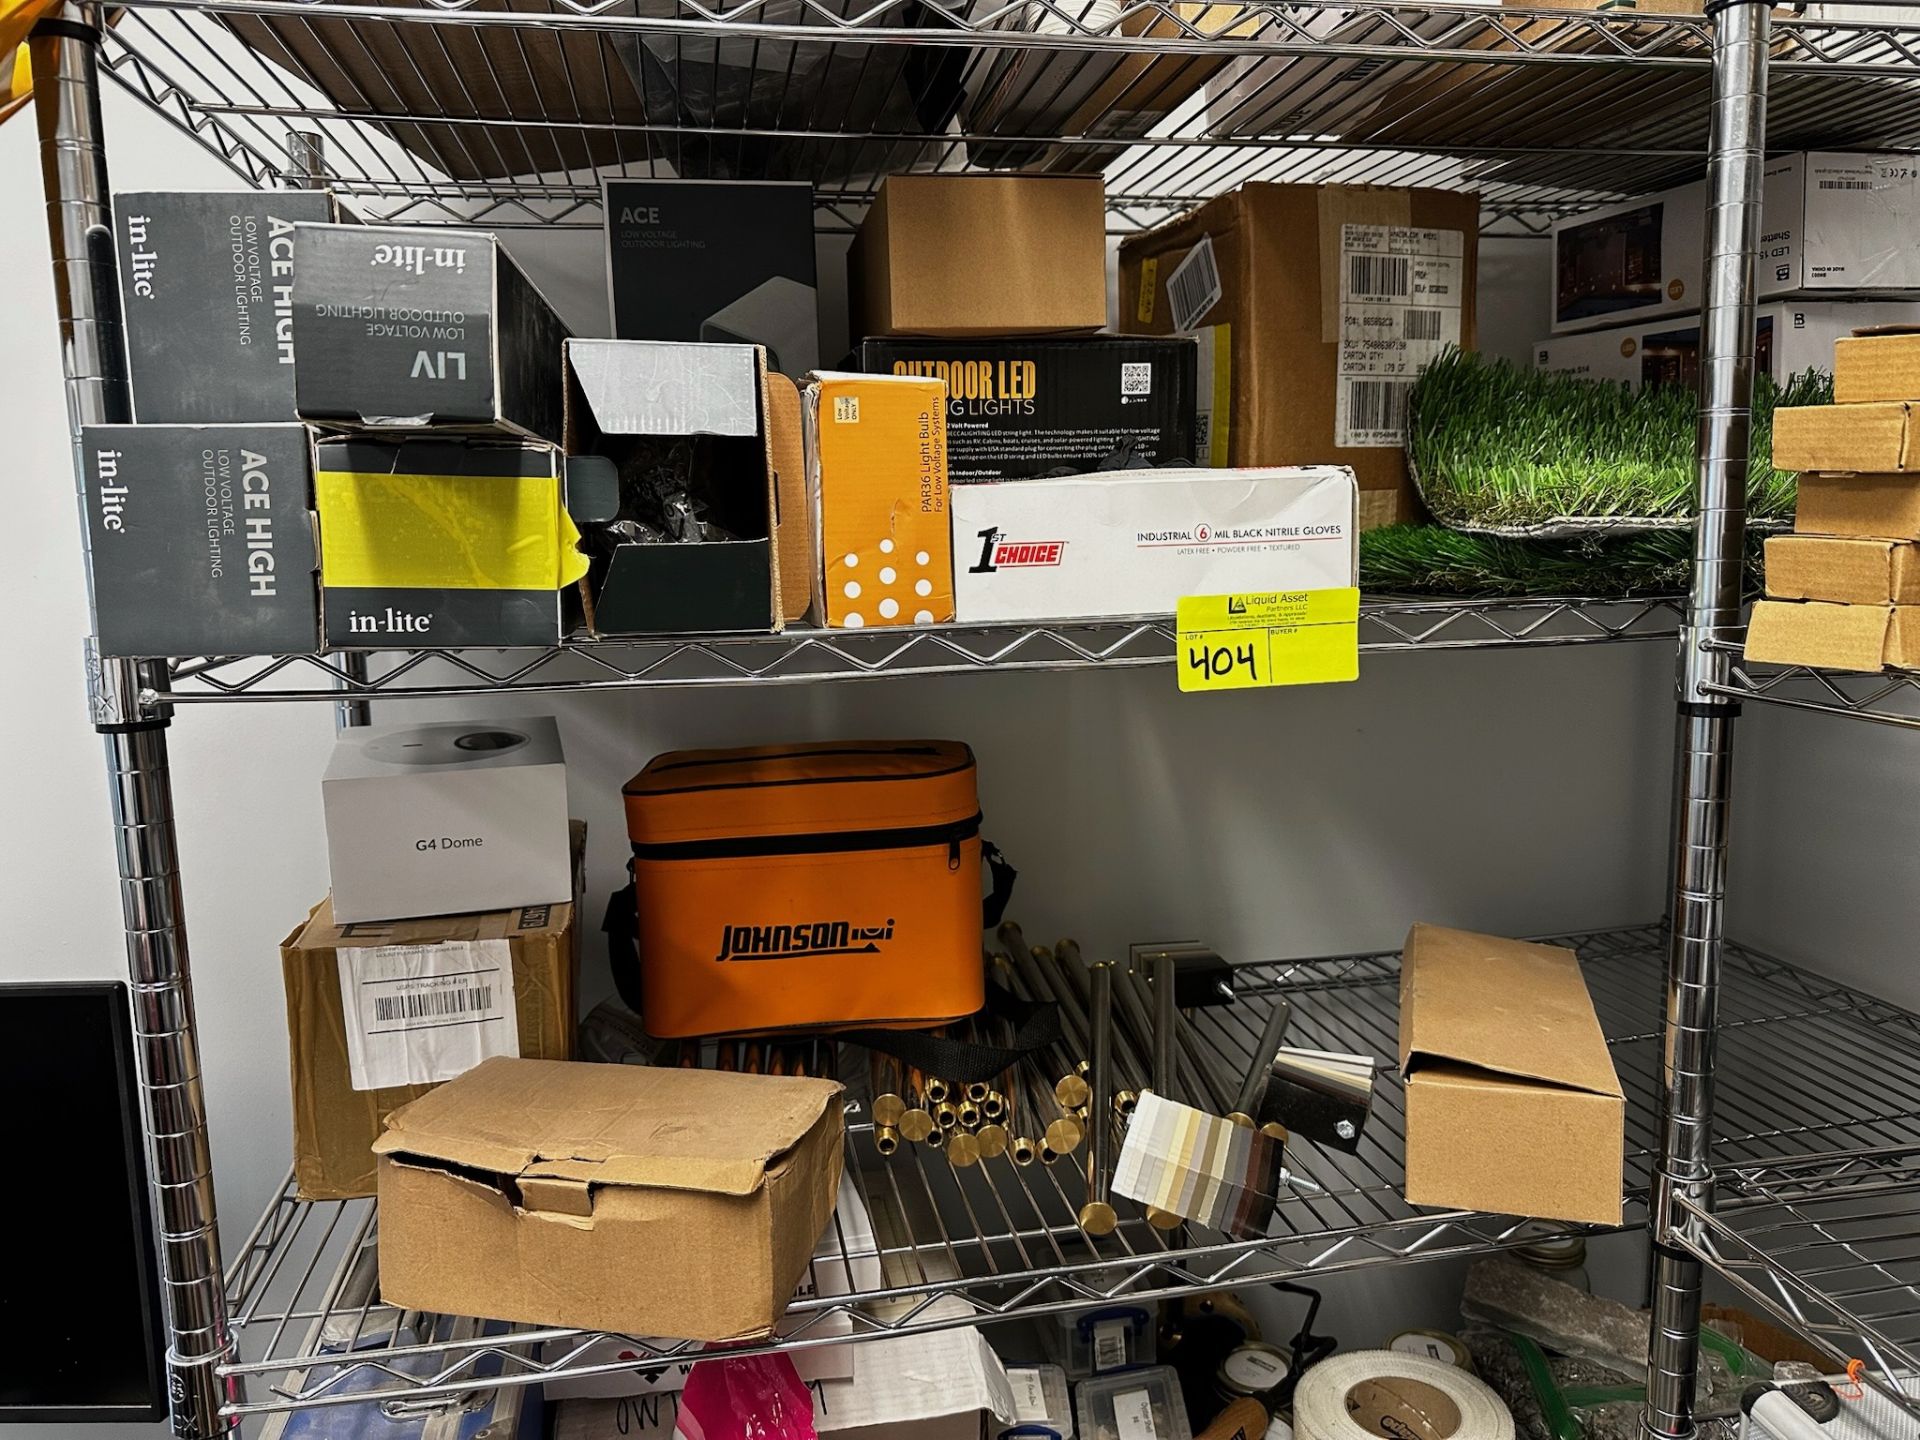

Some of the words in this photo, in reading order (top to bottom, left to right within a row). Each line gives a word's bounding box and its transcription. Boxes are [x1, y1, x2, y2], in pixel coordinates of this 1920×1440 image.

[620, 207, 660, 224] ACE
[244, 216, 255, 244] LOW
[621, 231, 639, 239] LOW
[640, 230, 678, 239] VOLTAGE
[127, 215, 156, 299] in-lite
[230, 215, 247, 280] OUTDOOR
[267, 215, 295, 278] ACE
[621, 239, 665, 249] OUTDOOR
[666, 240, 706, 249] LIGHTING
[1771, 246, 1791, 257] LED
[371, 244, 466, 275] in-lite
[247, 245, 263, 303] VOLTAGE
[236, 281, 251, 345] LIGHTING
[273, 285, 296, 364] HIGH
[316, 304, 391, 320] LIGHTING
[394, 308, 464, 322] OUTDOOR
[366, 323, 432, 338] VOLTAGE
[433, 325, 465, 341] LOW
[410, 350, 467, 380] LIV
[1343, 351, 1366, 361] CARTON
[1343, 362, 1366, 371] CARTON
[999, 361, 1036, 399] LED
[931, 396, 943, 435] Systems
[969, 400, 1035, 416] LIGHTS
[918, 411, 930, 438] Bulb
[217, 449, 229, 476] LOW
[919, 441, 933, 473] Light
[932, 438, 945, 473] Voltage
[97, 449, 127, 533] in-lite
[202, 449, 218, 517] OUTDOOR
[241, 449, 271, 510] ACE
[934, 475, 943, 495] Low
[220, 477, 235, 536] VOLTAGE
[921, 475, 932, 512] PAR36
[934, 498, 943, 513] For
[1137, 530, 1192, 542] INDUSTRIAL
[1199, 526, 1208, 540] 6
[1214, 528, 1231, 540] MIL
[1232, 527, 1263, 539] BLACK
[1265, 526, 1301, 538] NITRILE
[1303, 524, 1342, 536] GLOVES
[208, 518, 223, 578] LIGHTING
[246, 517, 276, 596] HIGH
[995, 543, 1060, 565] CHOICE
[1177, 546, 1194, 555] LATEX
[1195, 546, 1210, 554] FREE
[1217, 545, 1242, 554] POWDER
[1245, 545, 1262, 553] FREE
[1269, 543, 1300, 552] TEXTURED
[1246, 595, 1277, 607] Liquid
[1280, 593, 1308, 603] Asset
[1266, 604, 1294, 612] Partners
[1295, 603, 1308, 611] LLC
[349, 608, 430, 634] in-lite
[1189, 643, 1257, 681] 404
[416, 839, 437, 852] G4
[441, 836, 483, 849] Dome
[716, 921, 849, 962] JOHNSON
[417, 980, 450, 990] TRACKING
